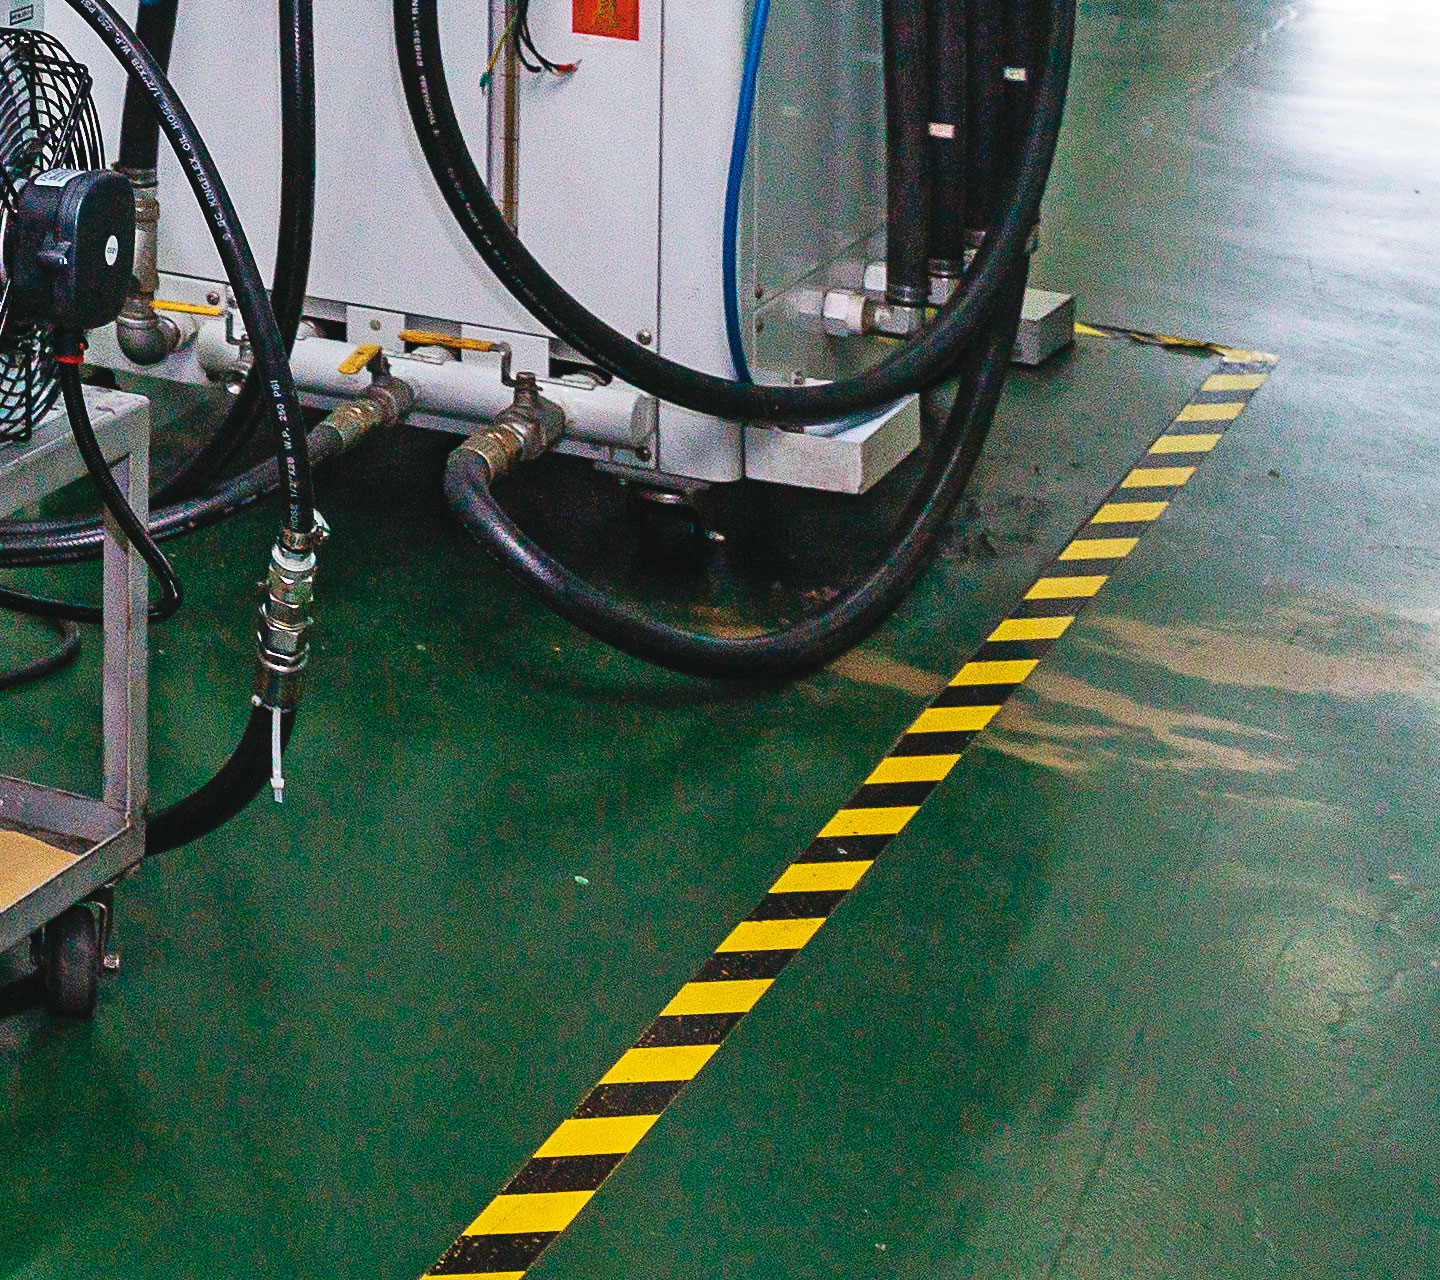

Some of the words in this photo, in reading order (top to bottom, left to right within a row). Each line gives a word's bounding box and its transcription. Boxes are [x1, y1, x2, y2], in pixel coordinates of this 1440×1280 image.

[97, 17, 112, 33] 250
[160, 104, 180, 130] HOSE
[178, 135, 192, 152] OIL
[188, 156, 220, 210] KINGFLEX
[213, 212, 225, 228] SC
[270, 379, 282, 397] PSI
[276, 403, 287, 422] 250
